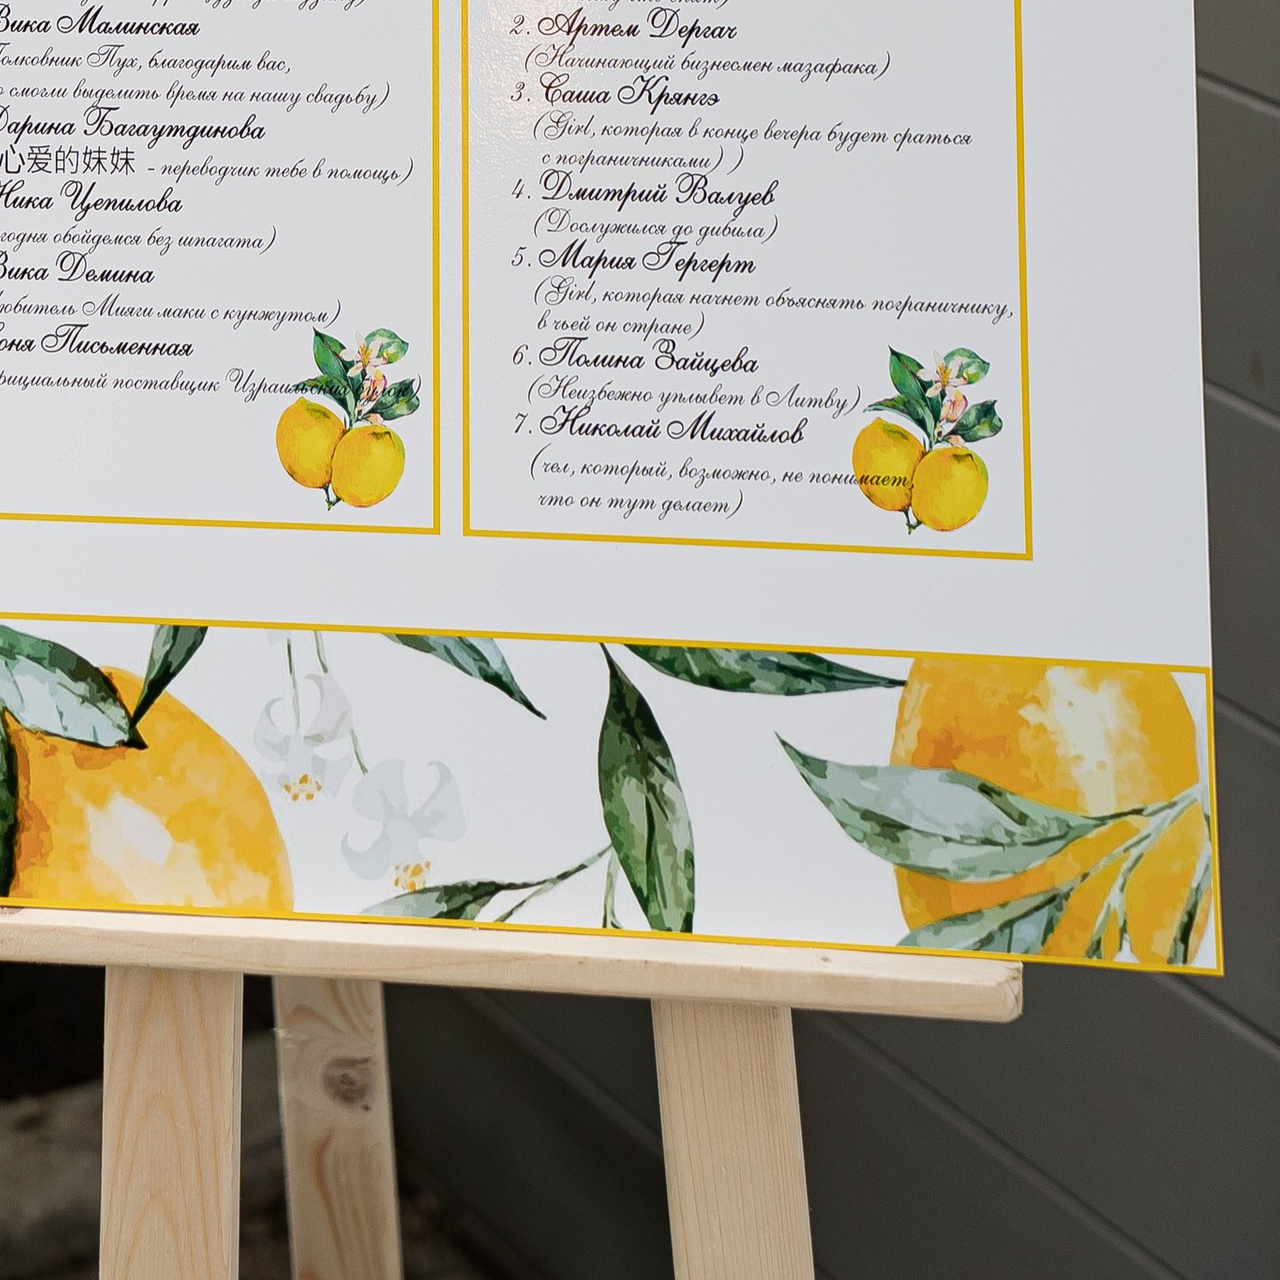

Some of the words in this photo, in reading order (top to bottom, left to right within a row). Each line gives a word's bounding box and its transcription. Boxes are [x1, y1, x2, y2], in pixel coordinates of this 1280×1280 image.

[508, 14, 531, 36] 2.
[537, 6, 641, 50] Артем
[646, 6, 738, 49] Дергач
[680, 49, 774, 81] бизнесмен
[510, 81, 531, 103] 3.
[539, 71, 612, 107] Саша
[82, 102, 267, 151] Багаутдинова
[600, 120, 684, 145] которая
[688, 116, 702, 139] в
[702, 127, 759, 144] конце
[763, 118, 822, 149] вечера
[827, 120, 889, 151] будет
[160, 155, 261, 187] переводчик
[264, 157, 308, 179] тебе
[312, 157, 326, 179] в
[541, 153, 552, 165] с
[511, 178, 531, 200] 4.
[538, 168, 669, 213] Дмитрий
[674, 168, 780, 222] Валуев
[670, 222, 694, 242] до
[55, 246, 156, 284] Демина
